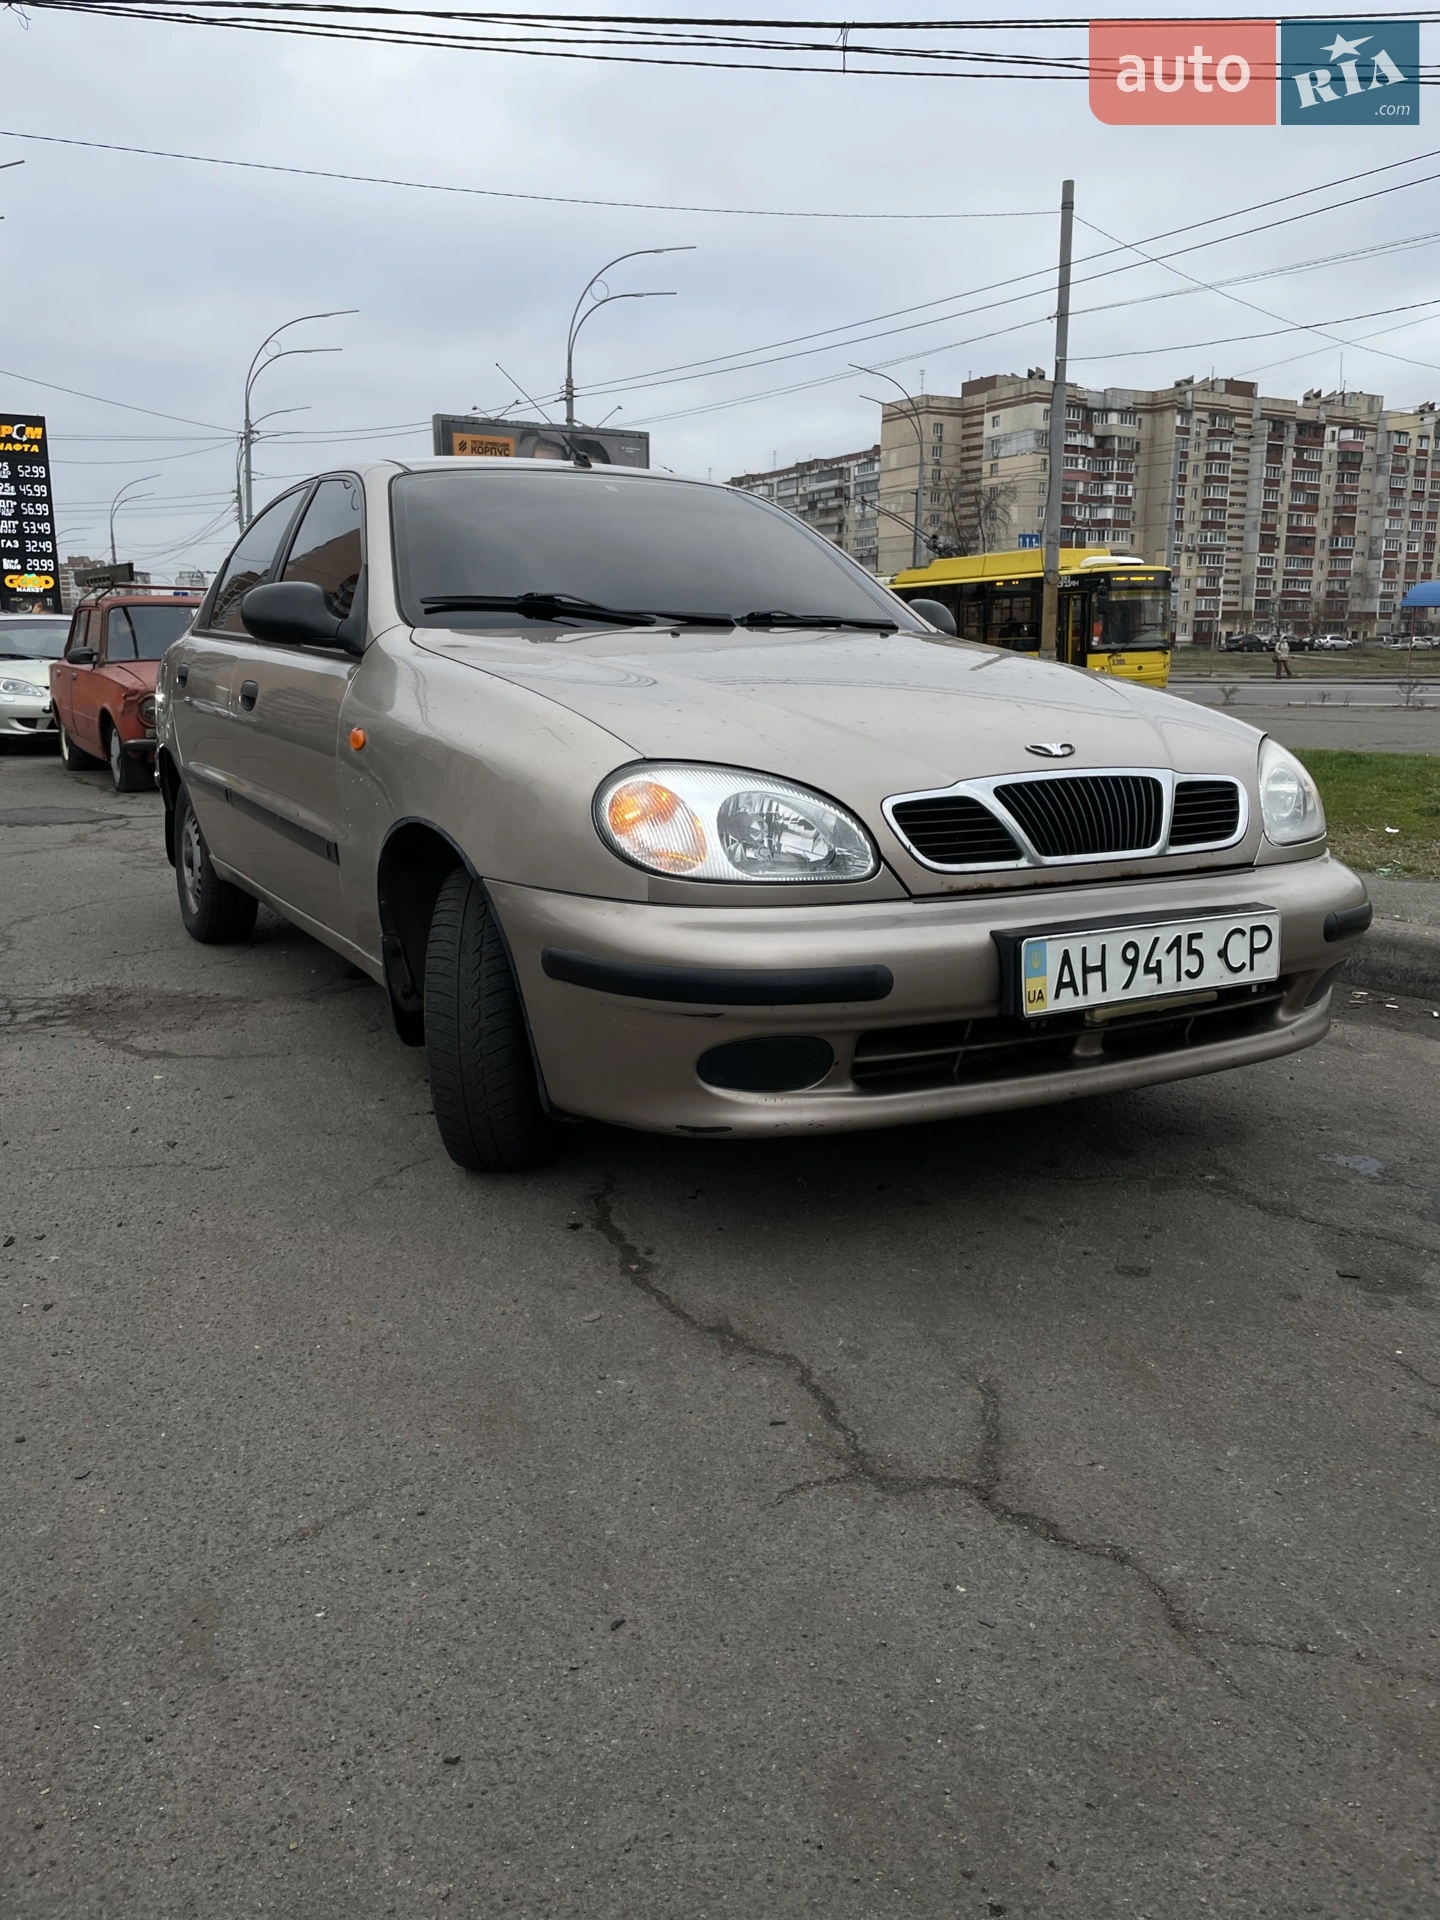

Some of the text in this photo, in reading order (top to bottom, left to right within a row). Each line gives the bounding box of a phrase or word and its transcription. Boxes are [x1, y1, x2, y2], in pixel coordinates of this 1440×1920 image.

[0, 424, 43, 442] РСМ
[470, 445, 510, 457] КОРПУС
[17, 465, 46, 478] 52.99
[19, 484, 48, 497] 45.99
[20, 502, 49, 516] 56.99
[22, 521, 51, 534] 53.49
[0, 539, 53, 553] ГАЗ 32.49
[26, 558, 54, 571] 29.99
[1054, 924, 1273, 1000] AH 9415 CP
[1027, 988, 1045, 1004] UA
